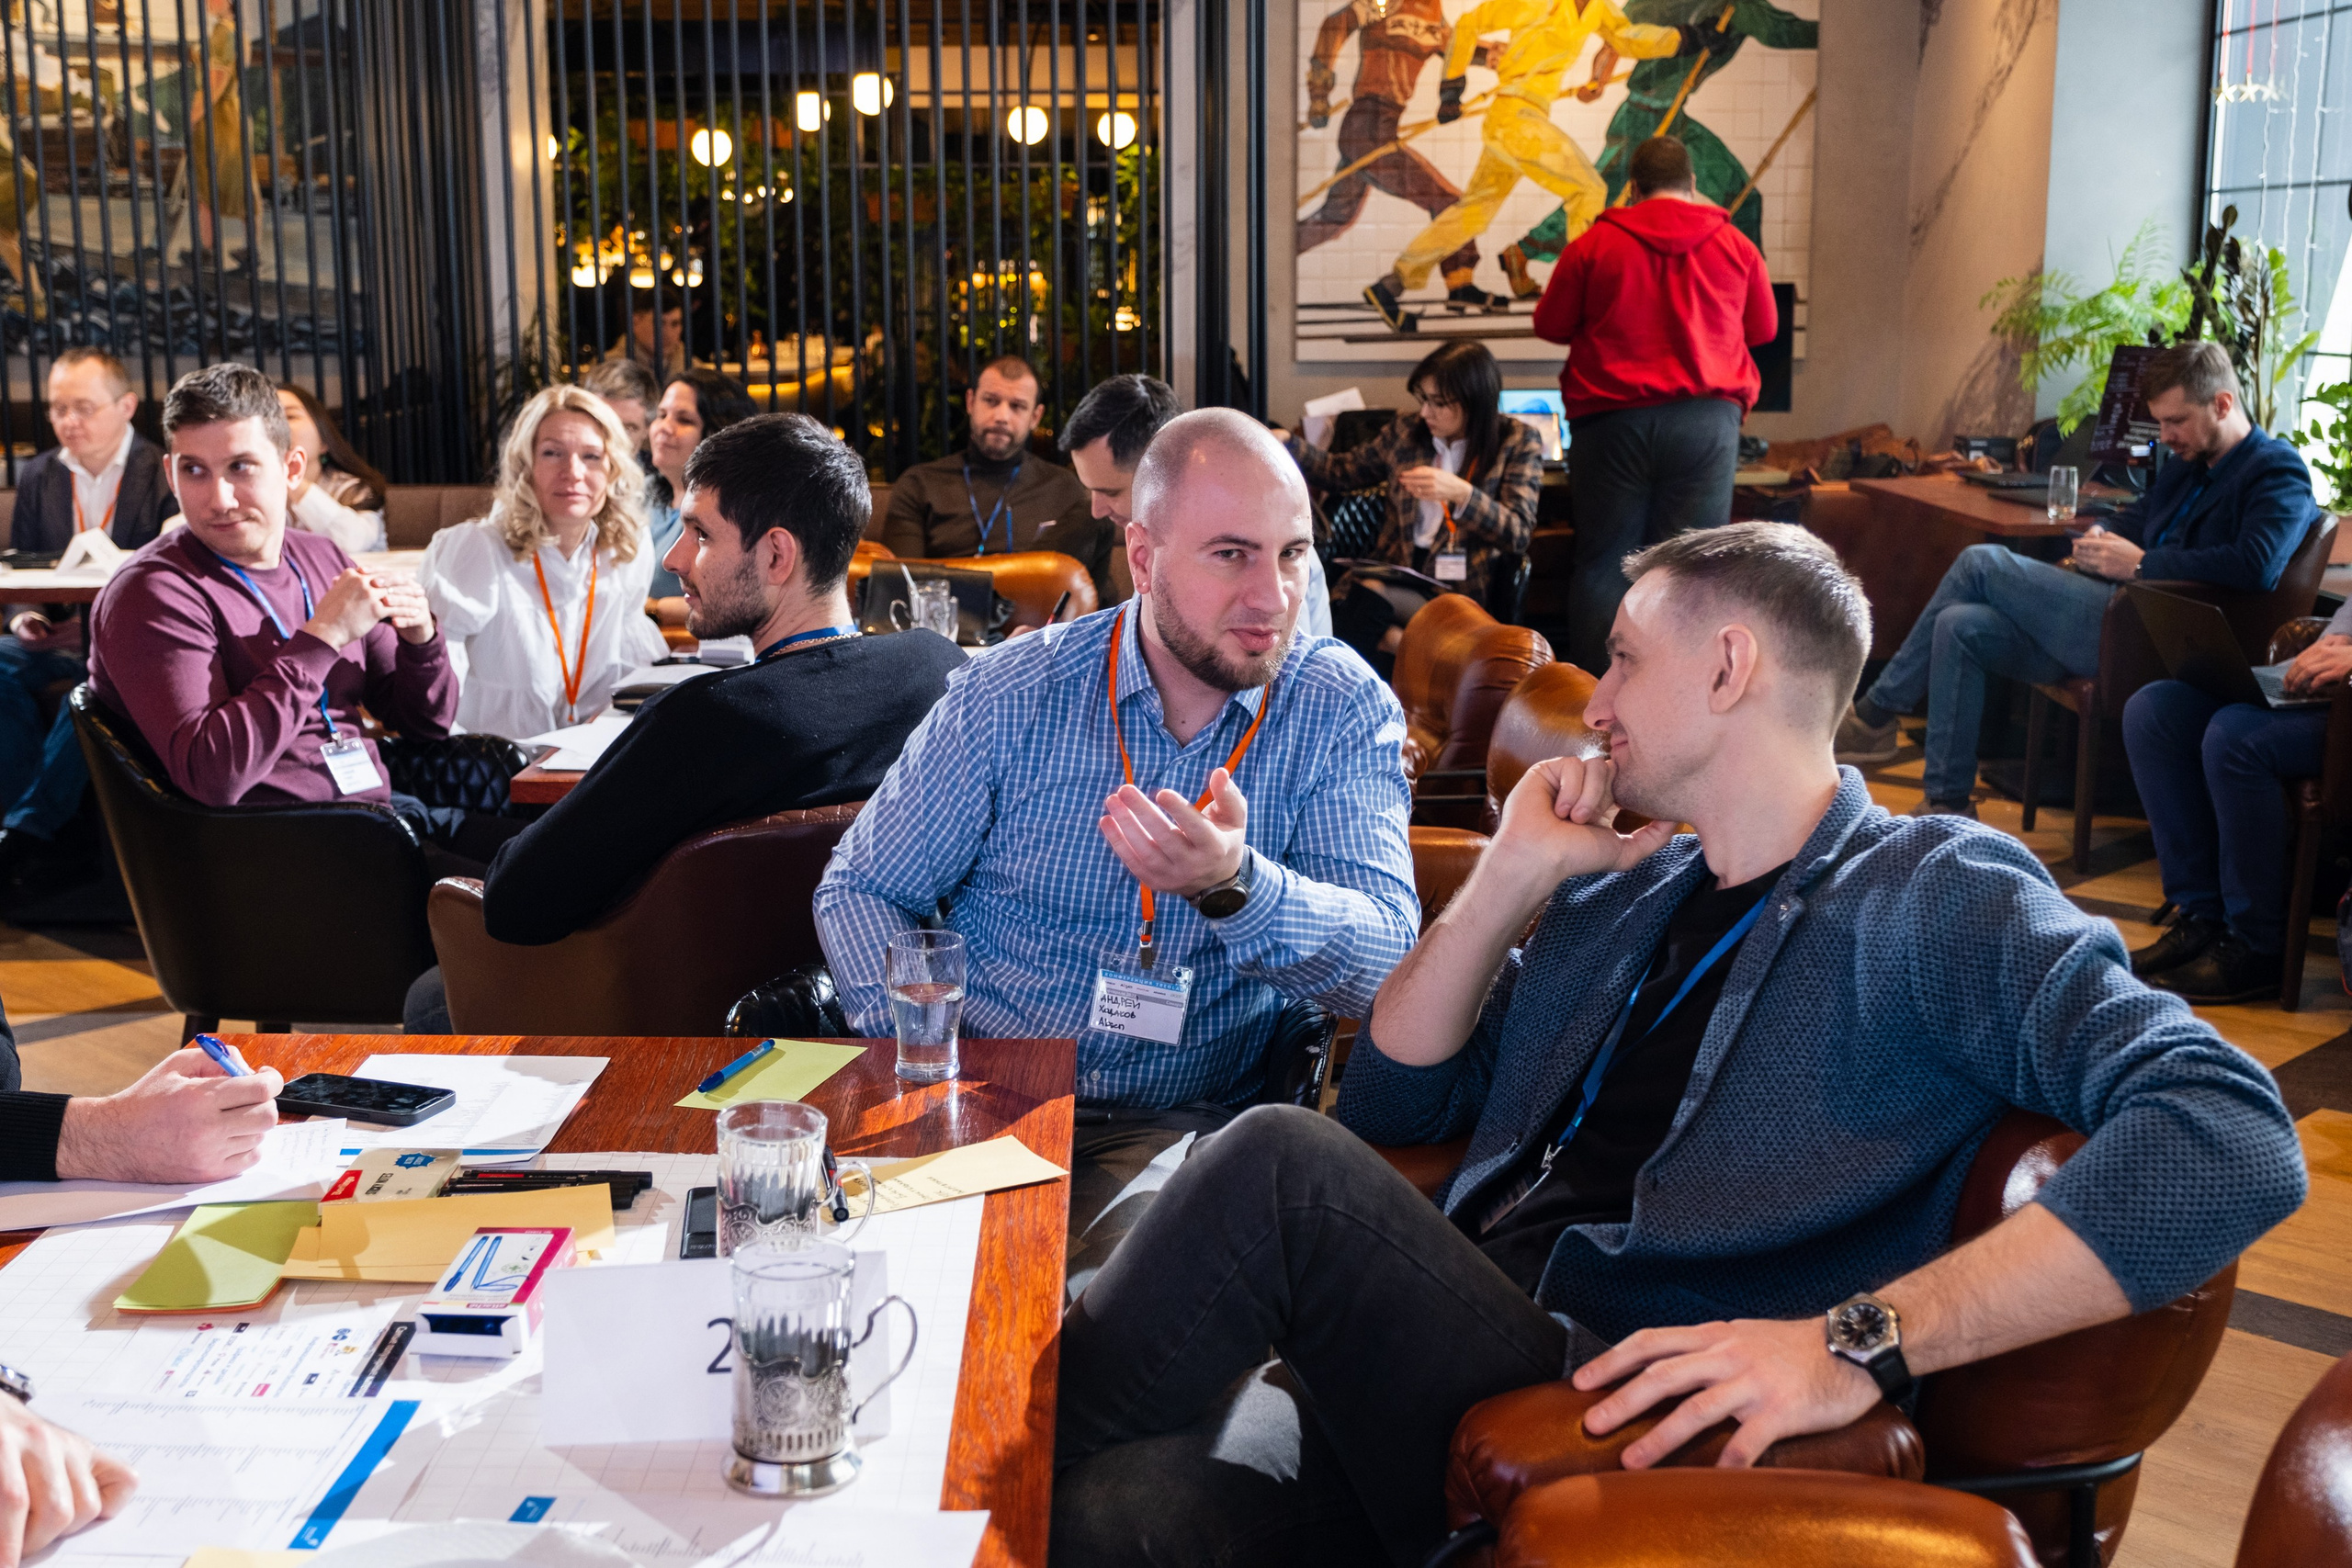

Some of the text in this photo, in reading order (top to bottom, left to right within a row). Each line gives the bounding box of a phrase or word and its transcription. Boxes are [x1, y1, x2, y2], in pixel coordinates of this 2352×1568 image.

[1104, 972, 1153, 985] КОНФЕРЕНЦИЯ
[1101, 994, 1141, 1010] АНДРЕЙ
[707, 1317, 732, 1374] 2
